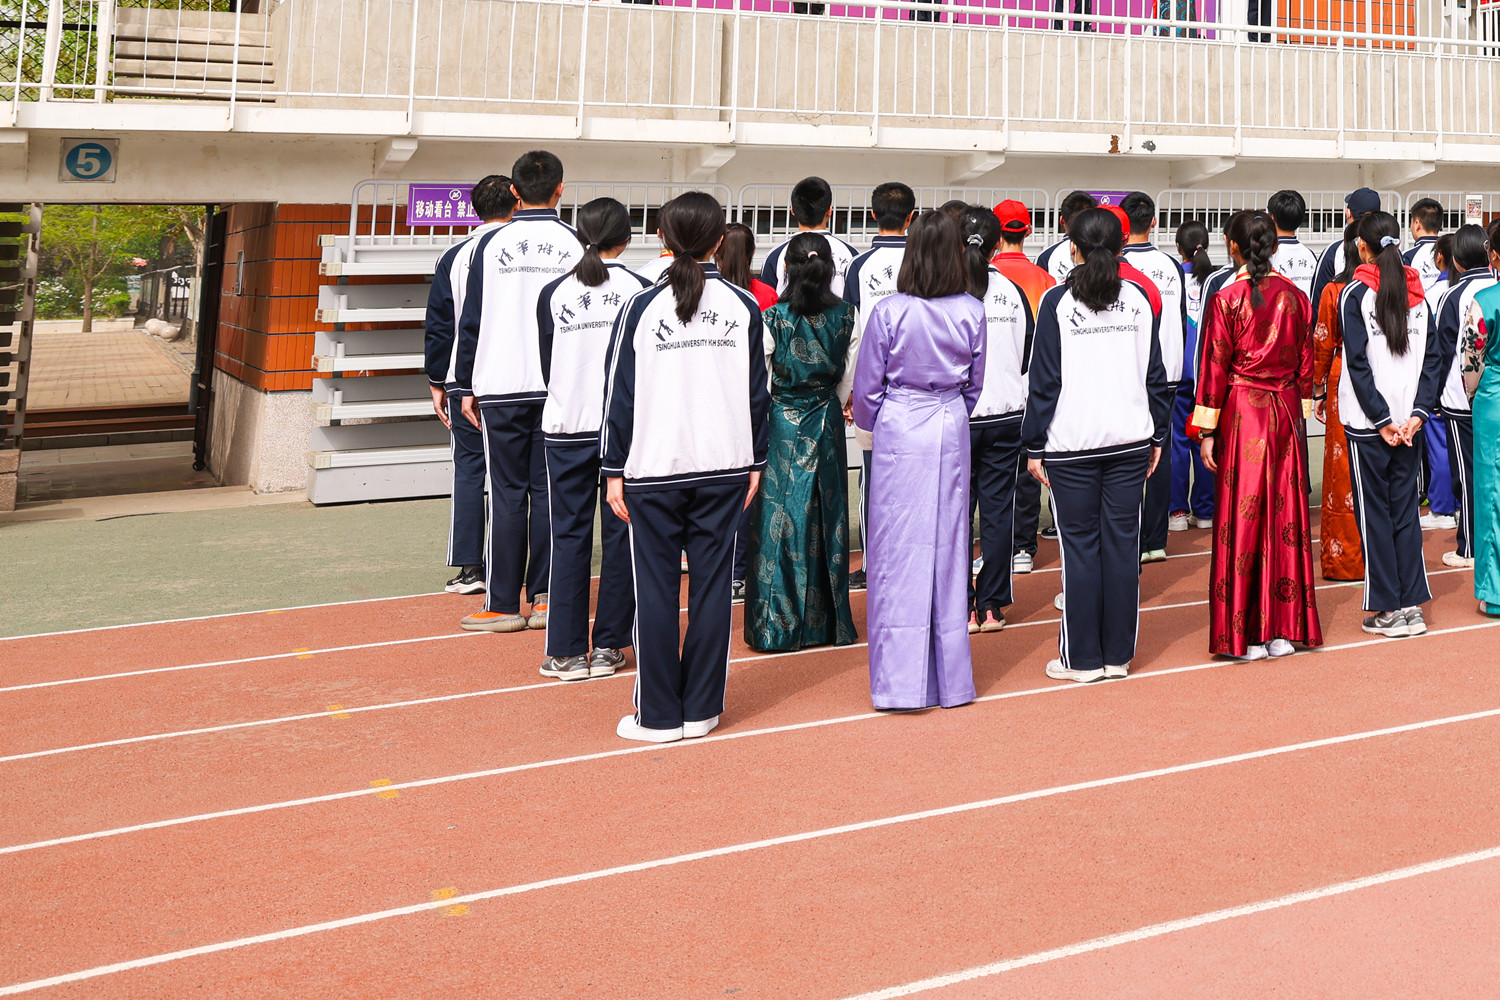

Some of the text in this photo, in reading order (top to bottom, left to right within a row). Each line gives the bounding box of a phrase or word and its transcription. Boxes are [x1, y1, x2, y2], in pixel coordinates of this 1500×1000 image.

[76, 148, 101, 176] 5
[415, 200, 479, 218] 移动看台 禁止
[560, 323, 580, 334] TSINGHUA
[581, 321, 608, 330] UNIVERSITY
[656, 341, 680, 352] TSINGHUA
[681, 339, 707, 348] UNIVERSITY
[717, 339, 737, 348] SCHOOL
